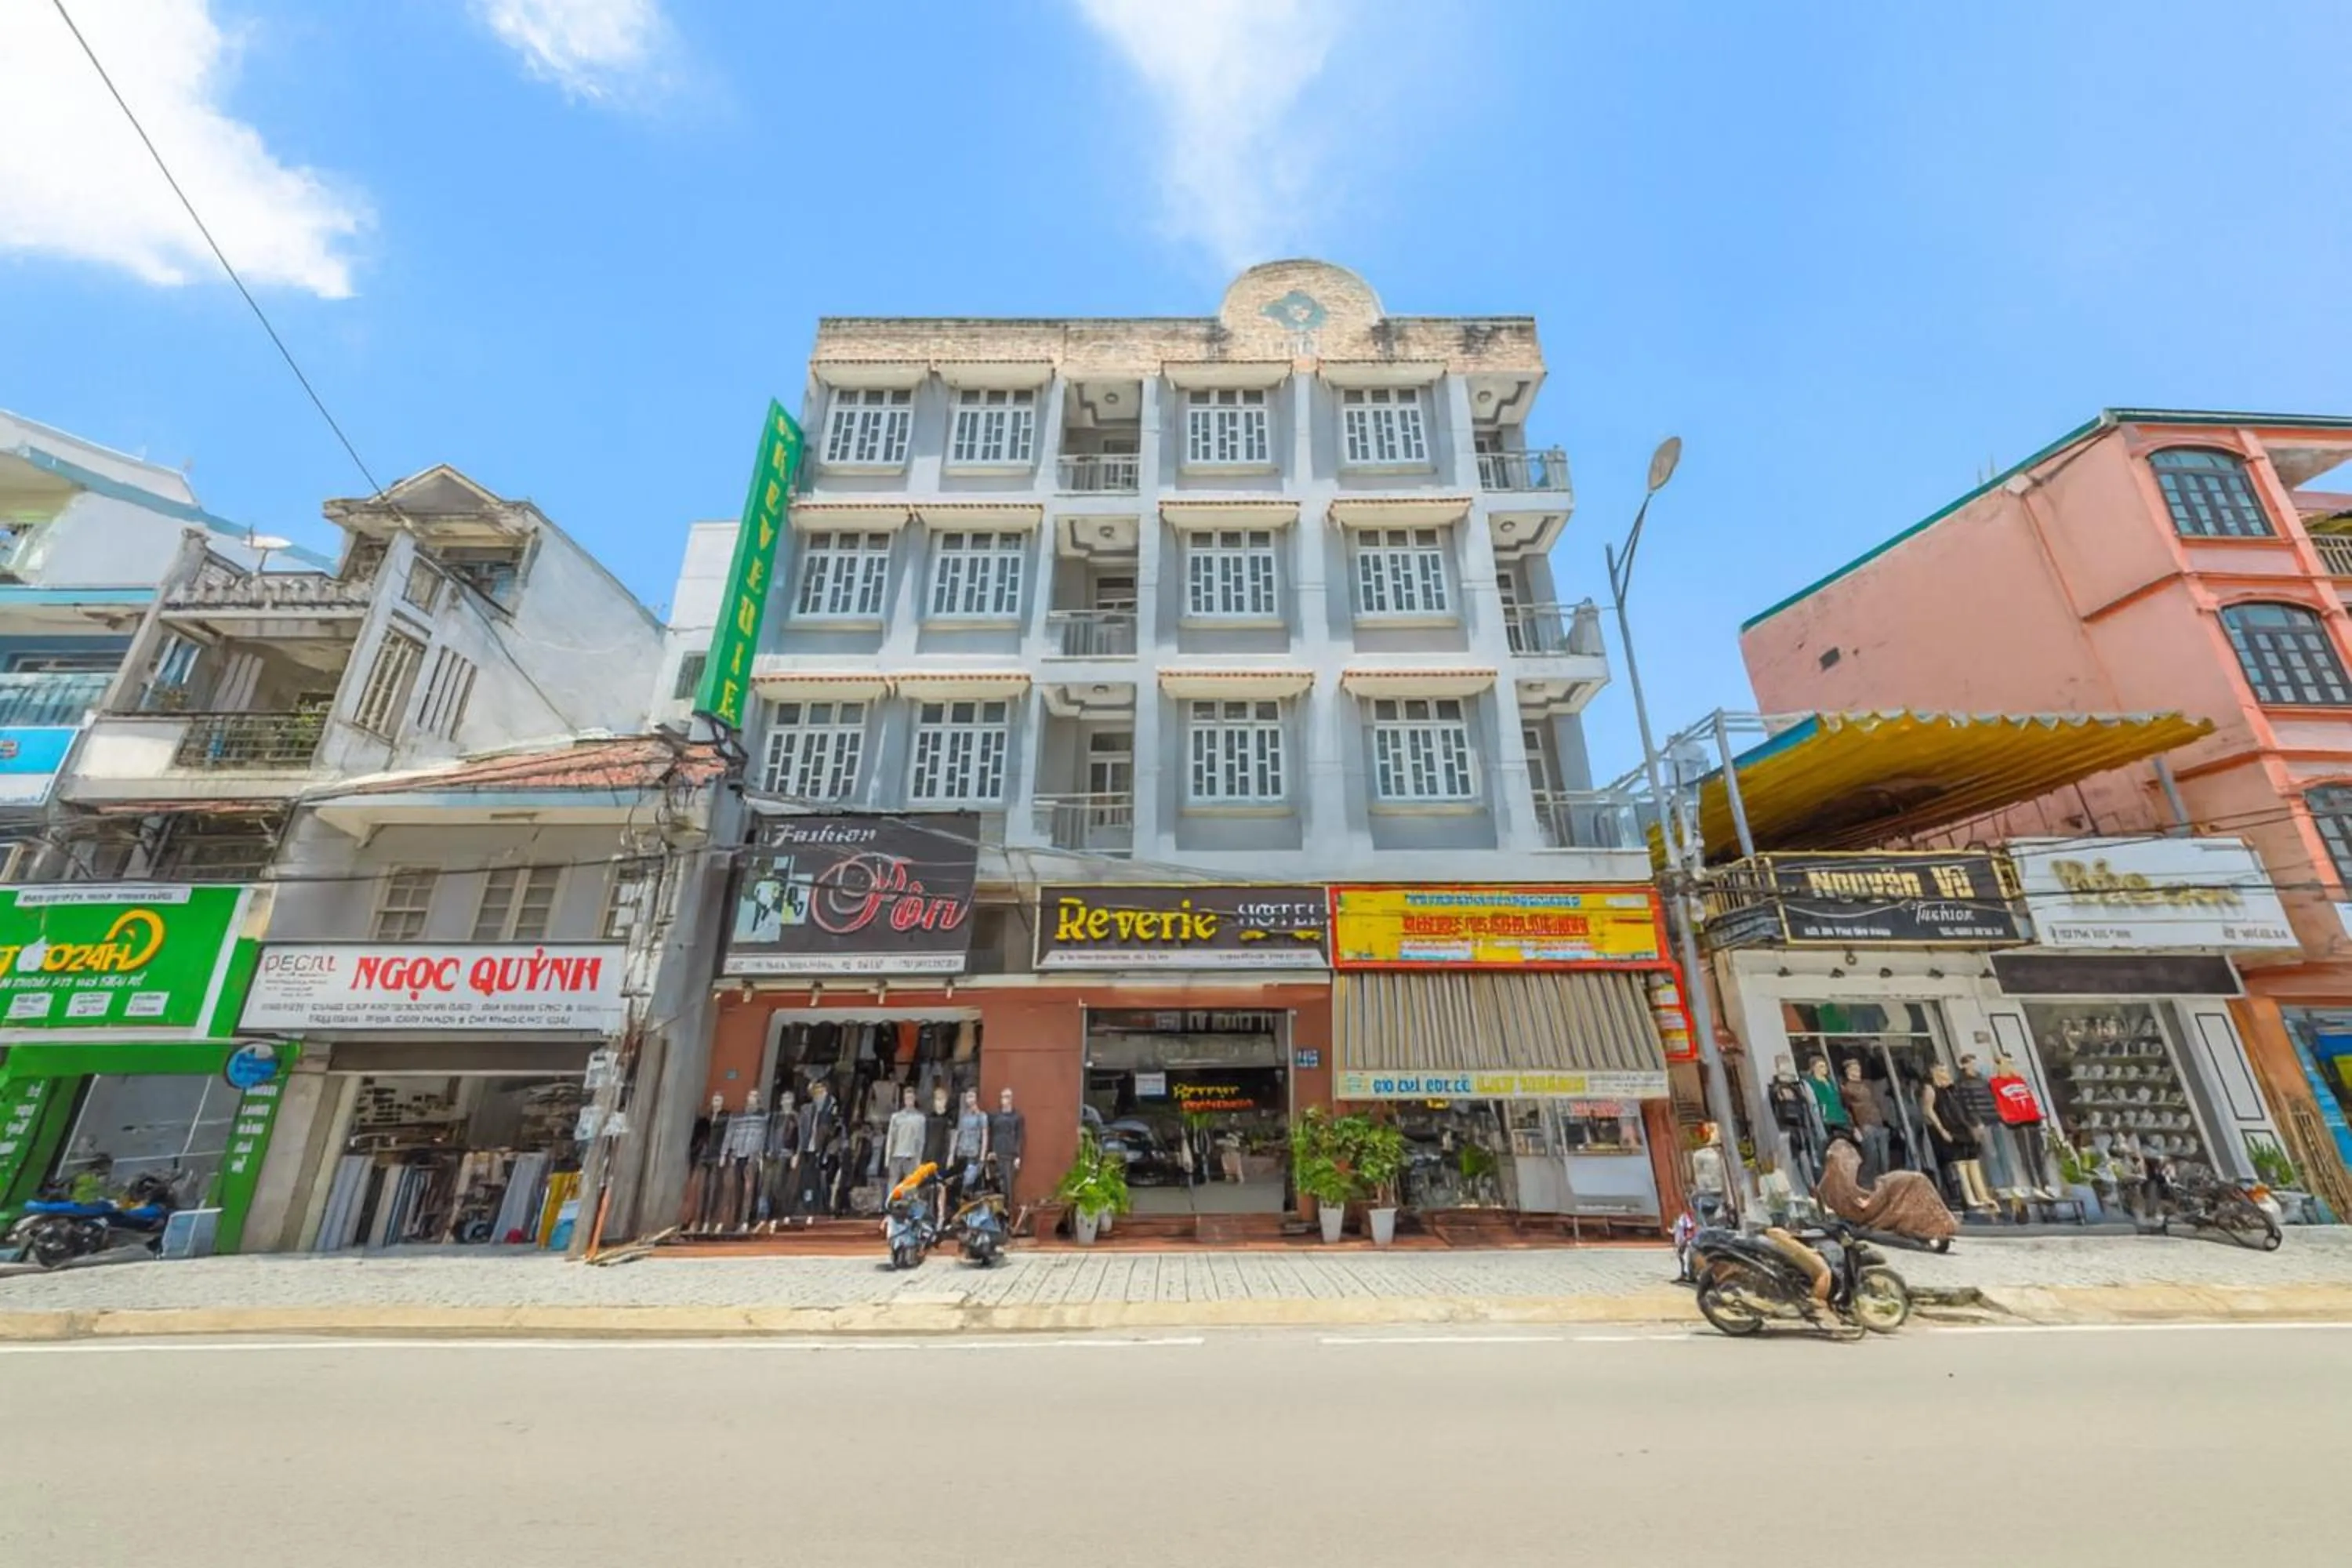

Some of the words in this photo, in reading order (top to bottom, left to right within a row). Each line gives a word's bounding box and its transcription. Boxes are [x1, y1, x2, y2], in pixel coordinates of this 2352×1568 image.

[770, 824, 877, 848] Fashion
[1054, 897, 1218, 940] Reverie
[265, 955, 337, 972] DECAL
[350, 956, 460, 1001] NGỌC
